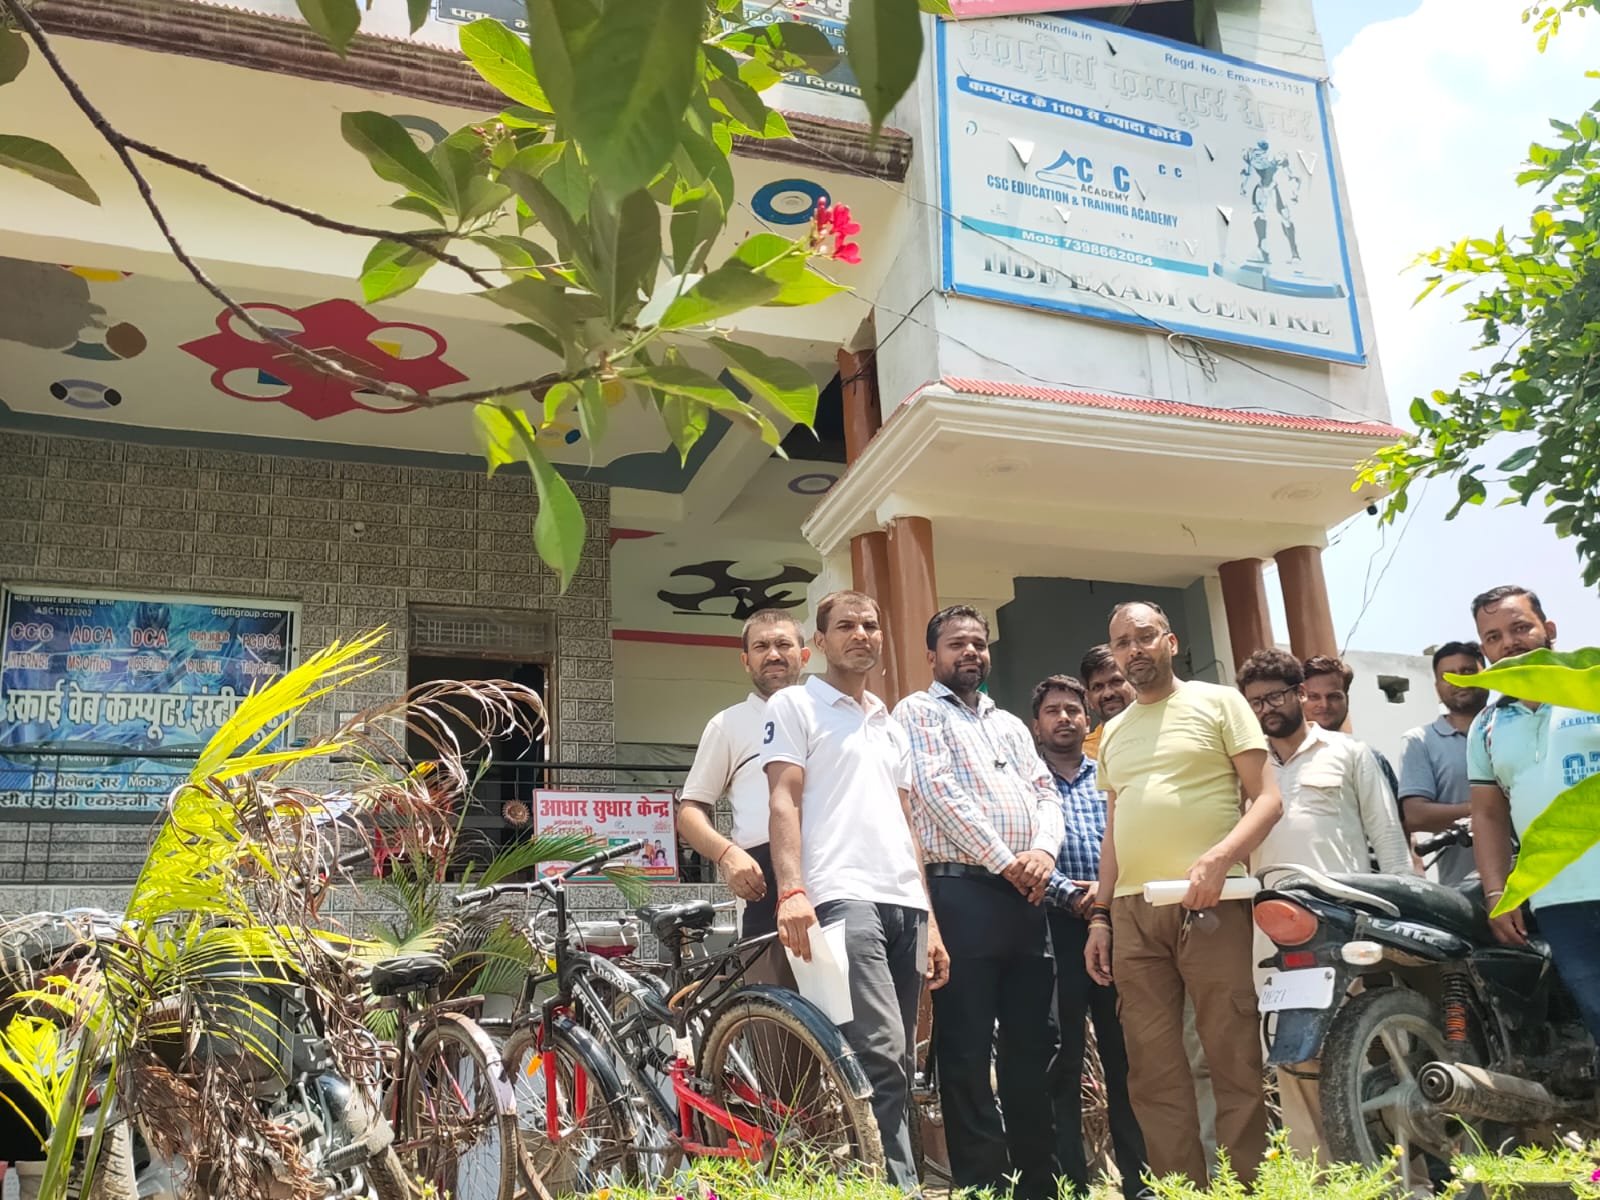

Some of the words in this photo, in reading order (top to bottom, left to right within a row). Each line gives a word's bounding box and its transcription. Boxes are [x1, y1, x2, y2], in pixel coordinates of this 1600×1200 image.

[1164, 53, 1199, 71] Regd.
[1051, 102, 1083, 118] 1100
[987, 174, 1009, 192] CSC
[1011, 179, 1069, 206] EDUCATION
[1072, 196, 1079, 206] &
[1082, 196, 1129, 217] TRAINING
[1131, 207, 1178, 228] ACADEMY
[1080, 183, 1129, 202] ACADEMY
[1021, 230, 1059, 247] Mob:
[1188, 291, 1332, 336] CENTRE
[211, 607, 282, 619] digifigroup.com
[11, 622, 54, 642] CCC
[70, 625, 115, 645] ADCA
[131, 627, 169, 648] DCA
[7, 679, 65, 731] स्काई
[68, 682, 102, 725] वेब
[105, 691, 189, 740] कम्प्यूटर
[763, 721, 775, 744] 3
[540, 799, 588, 817] आधार
[592, 800, 632, 823] सुधार
[636, 796, 670, 818] केन्द्र
